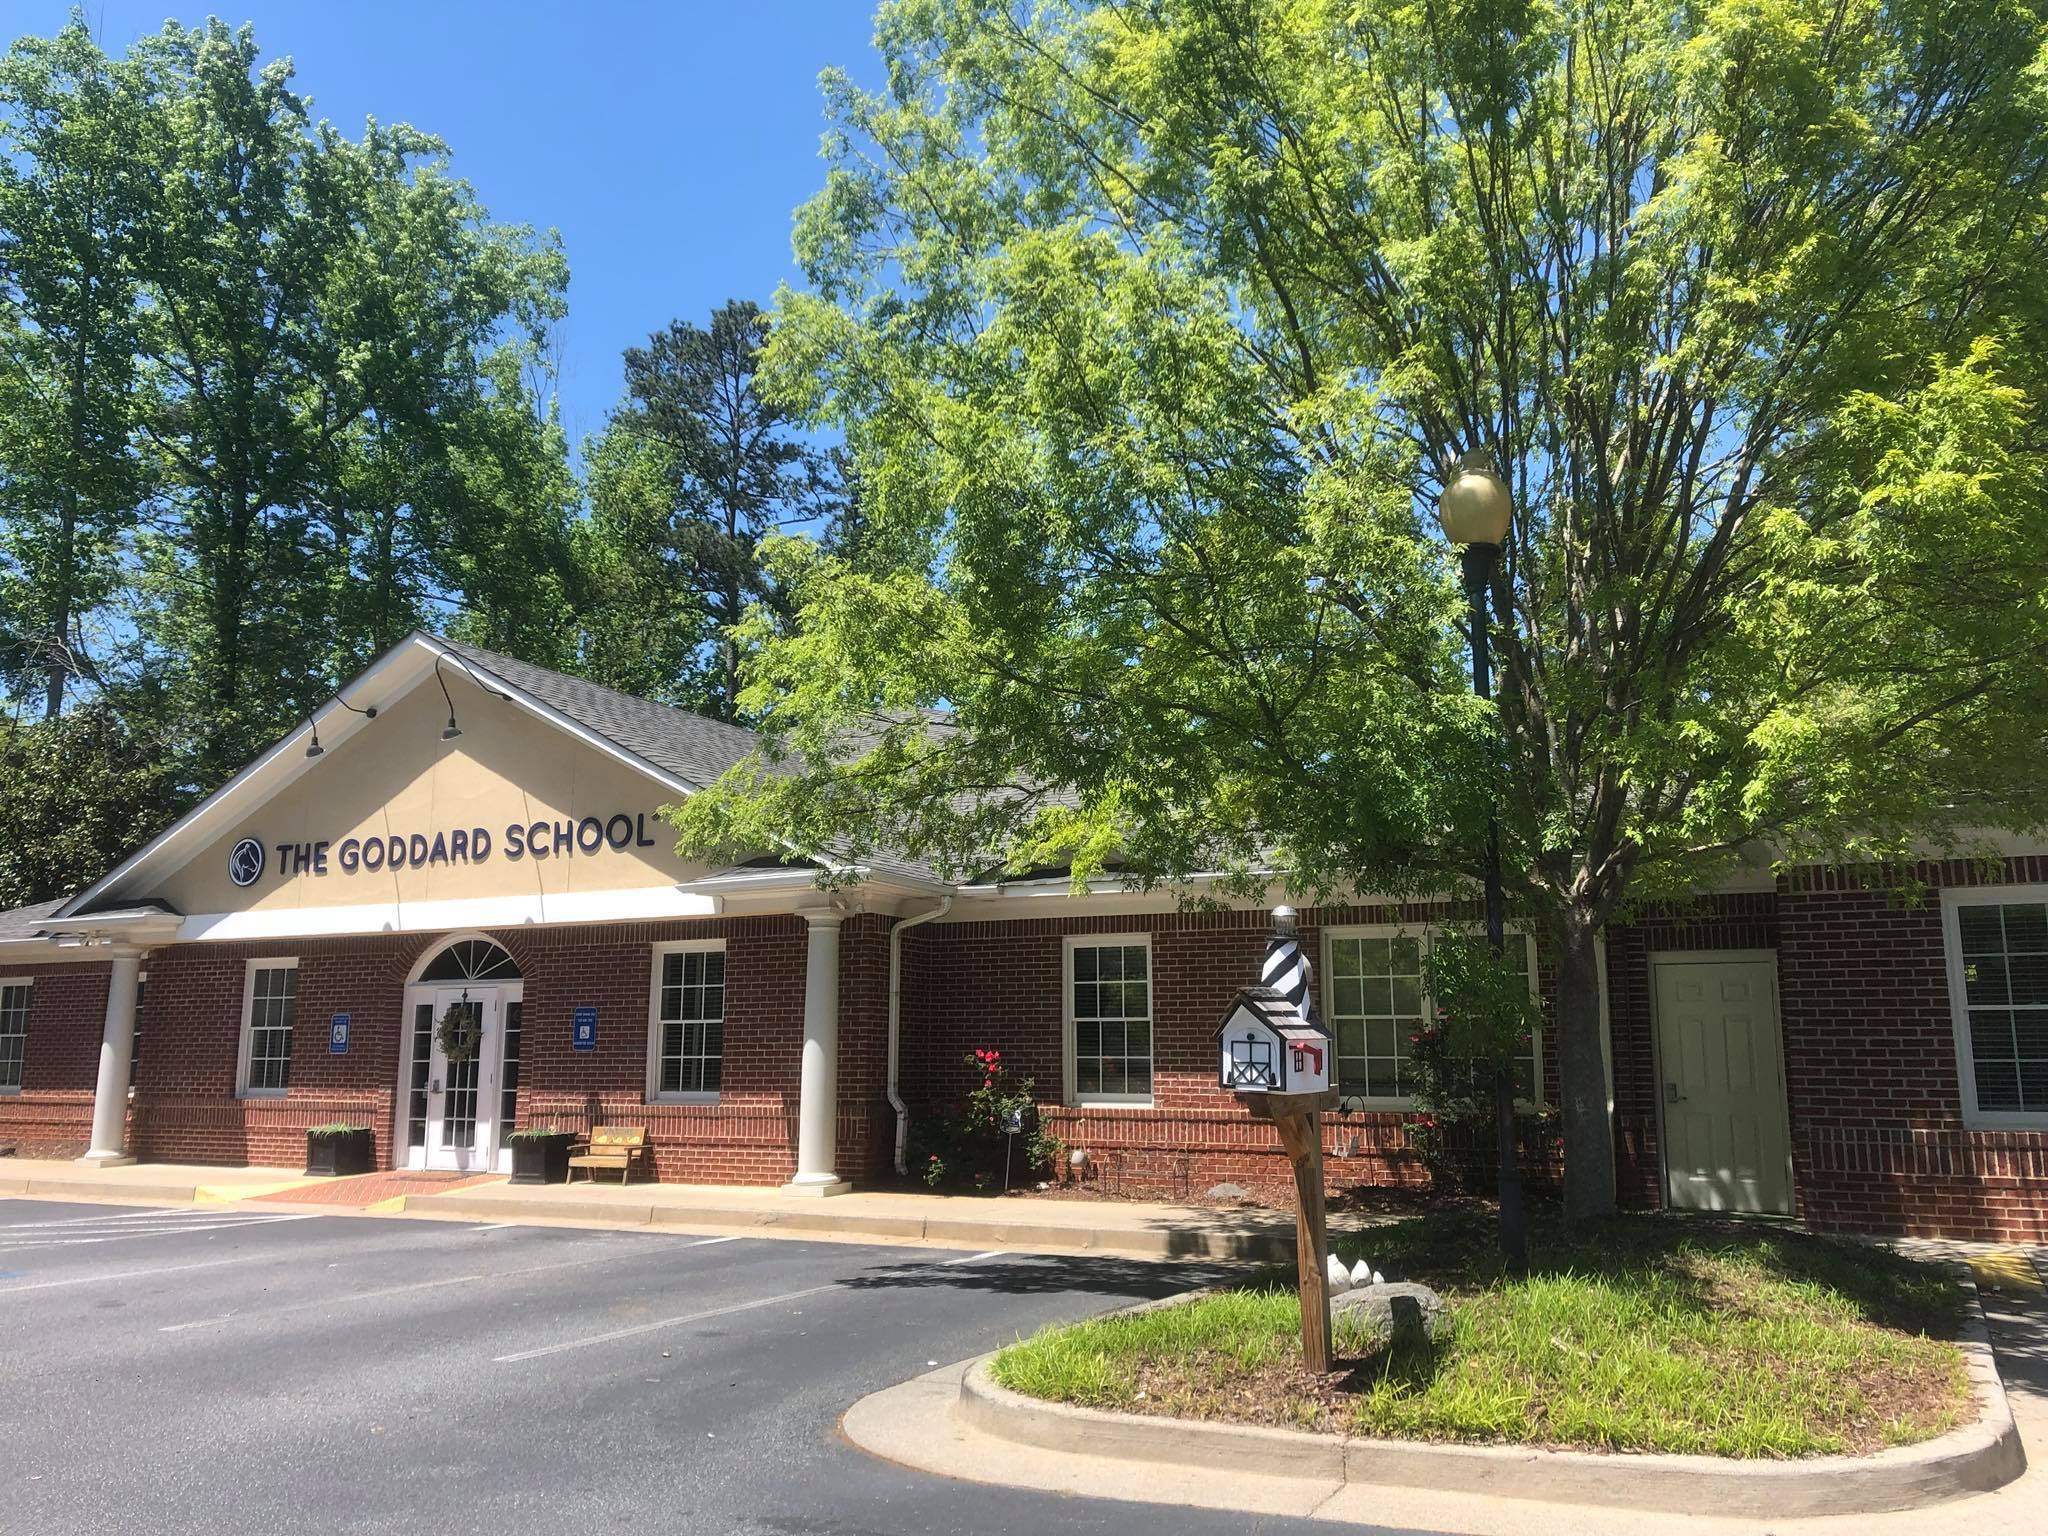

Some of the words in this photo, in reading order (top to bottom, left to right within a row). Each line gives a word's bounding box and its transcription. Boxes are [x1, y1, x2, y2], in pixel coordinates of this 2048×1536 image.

[276, 841, 329, 875] THE
[339, 828, 491, 870] GODDARD
[504, 813, 655, 857] SCHOOL
